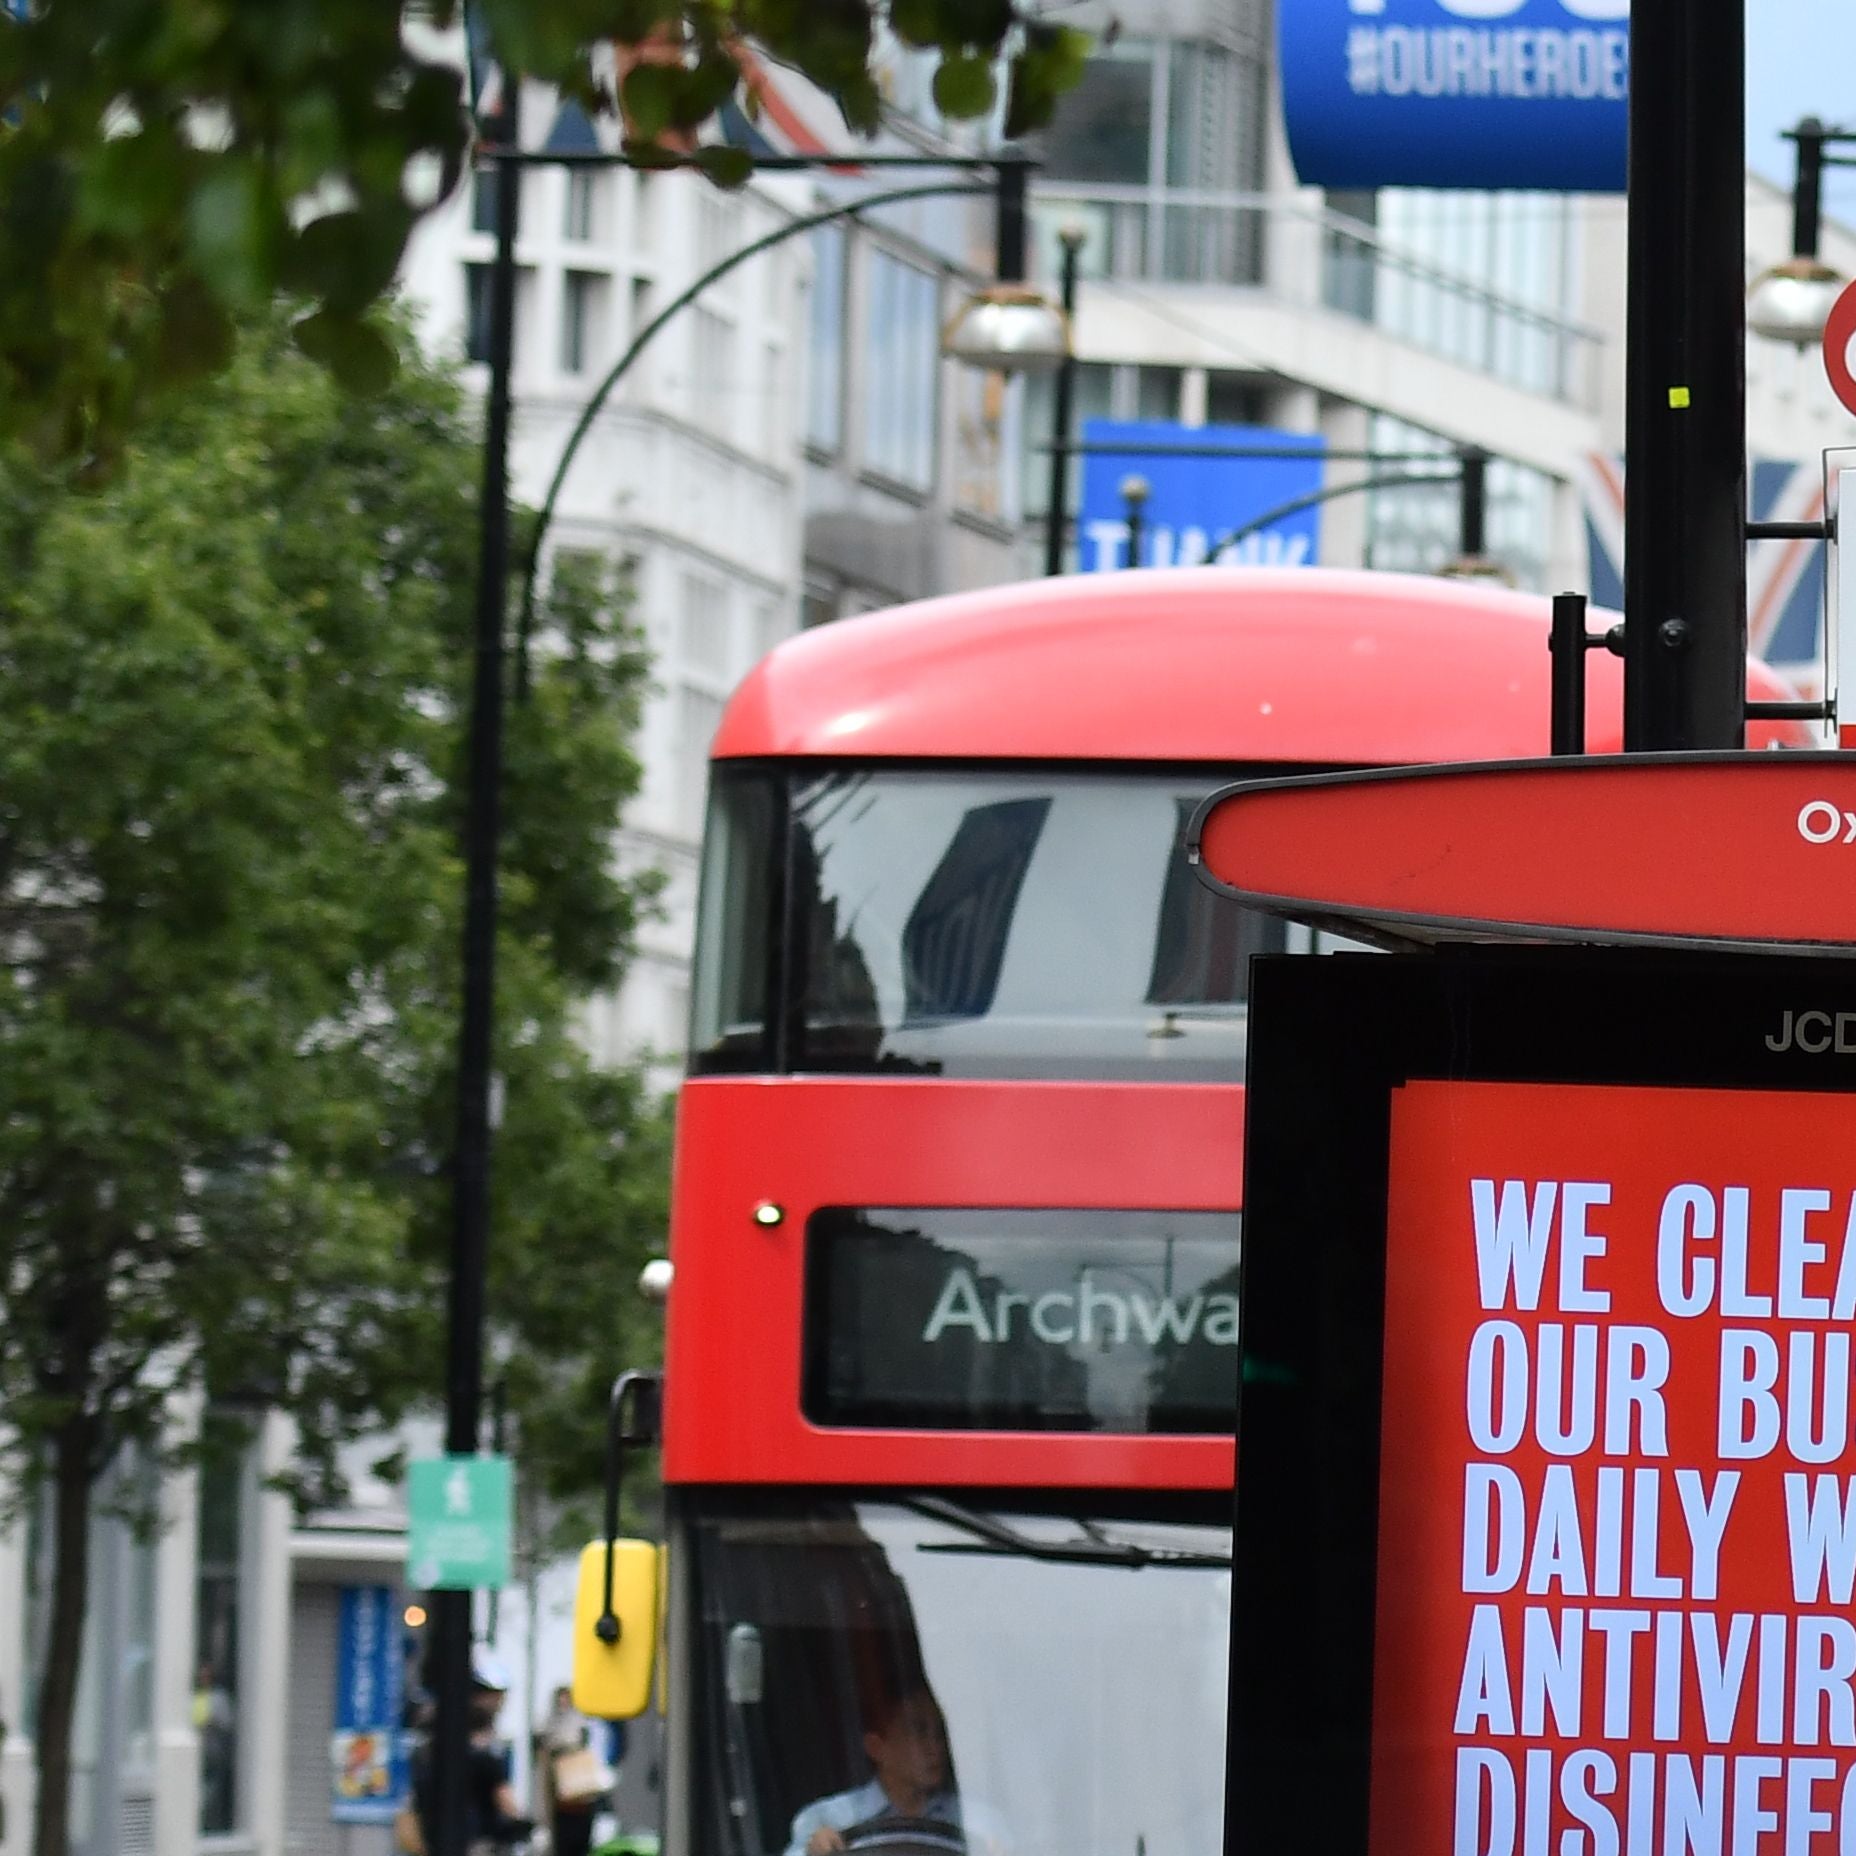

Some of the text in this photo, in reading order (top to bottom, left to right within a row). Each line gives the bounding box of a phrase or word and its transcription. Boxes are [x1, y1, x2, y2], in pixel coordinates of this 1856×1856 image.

[1347, 25, 1630, 99] #OURHEROE
[922, 1266, 1239, 1344] Archwa
[1471, 1179, 1611, 1312] WE
[1466, 1320, 1670, 1456] OUR
[1462, 1463, 1741, 1599] DAILY
